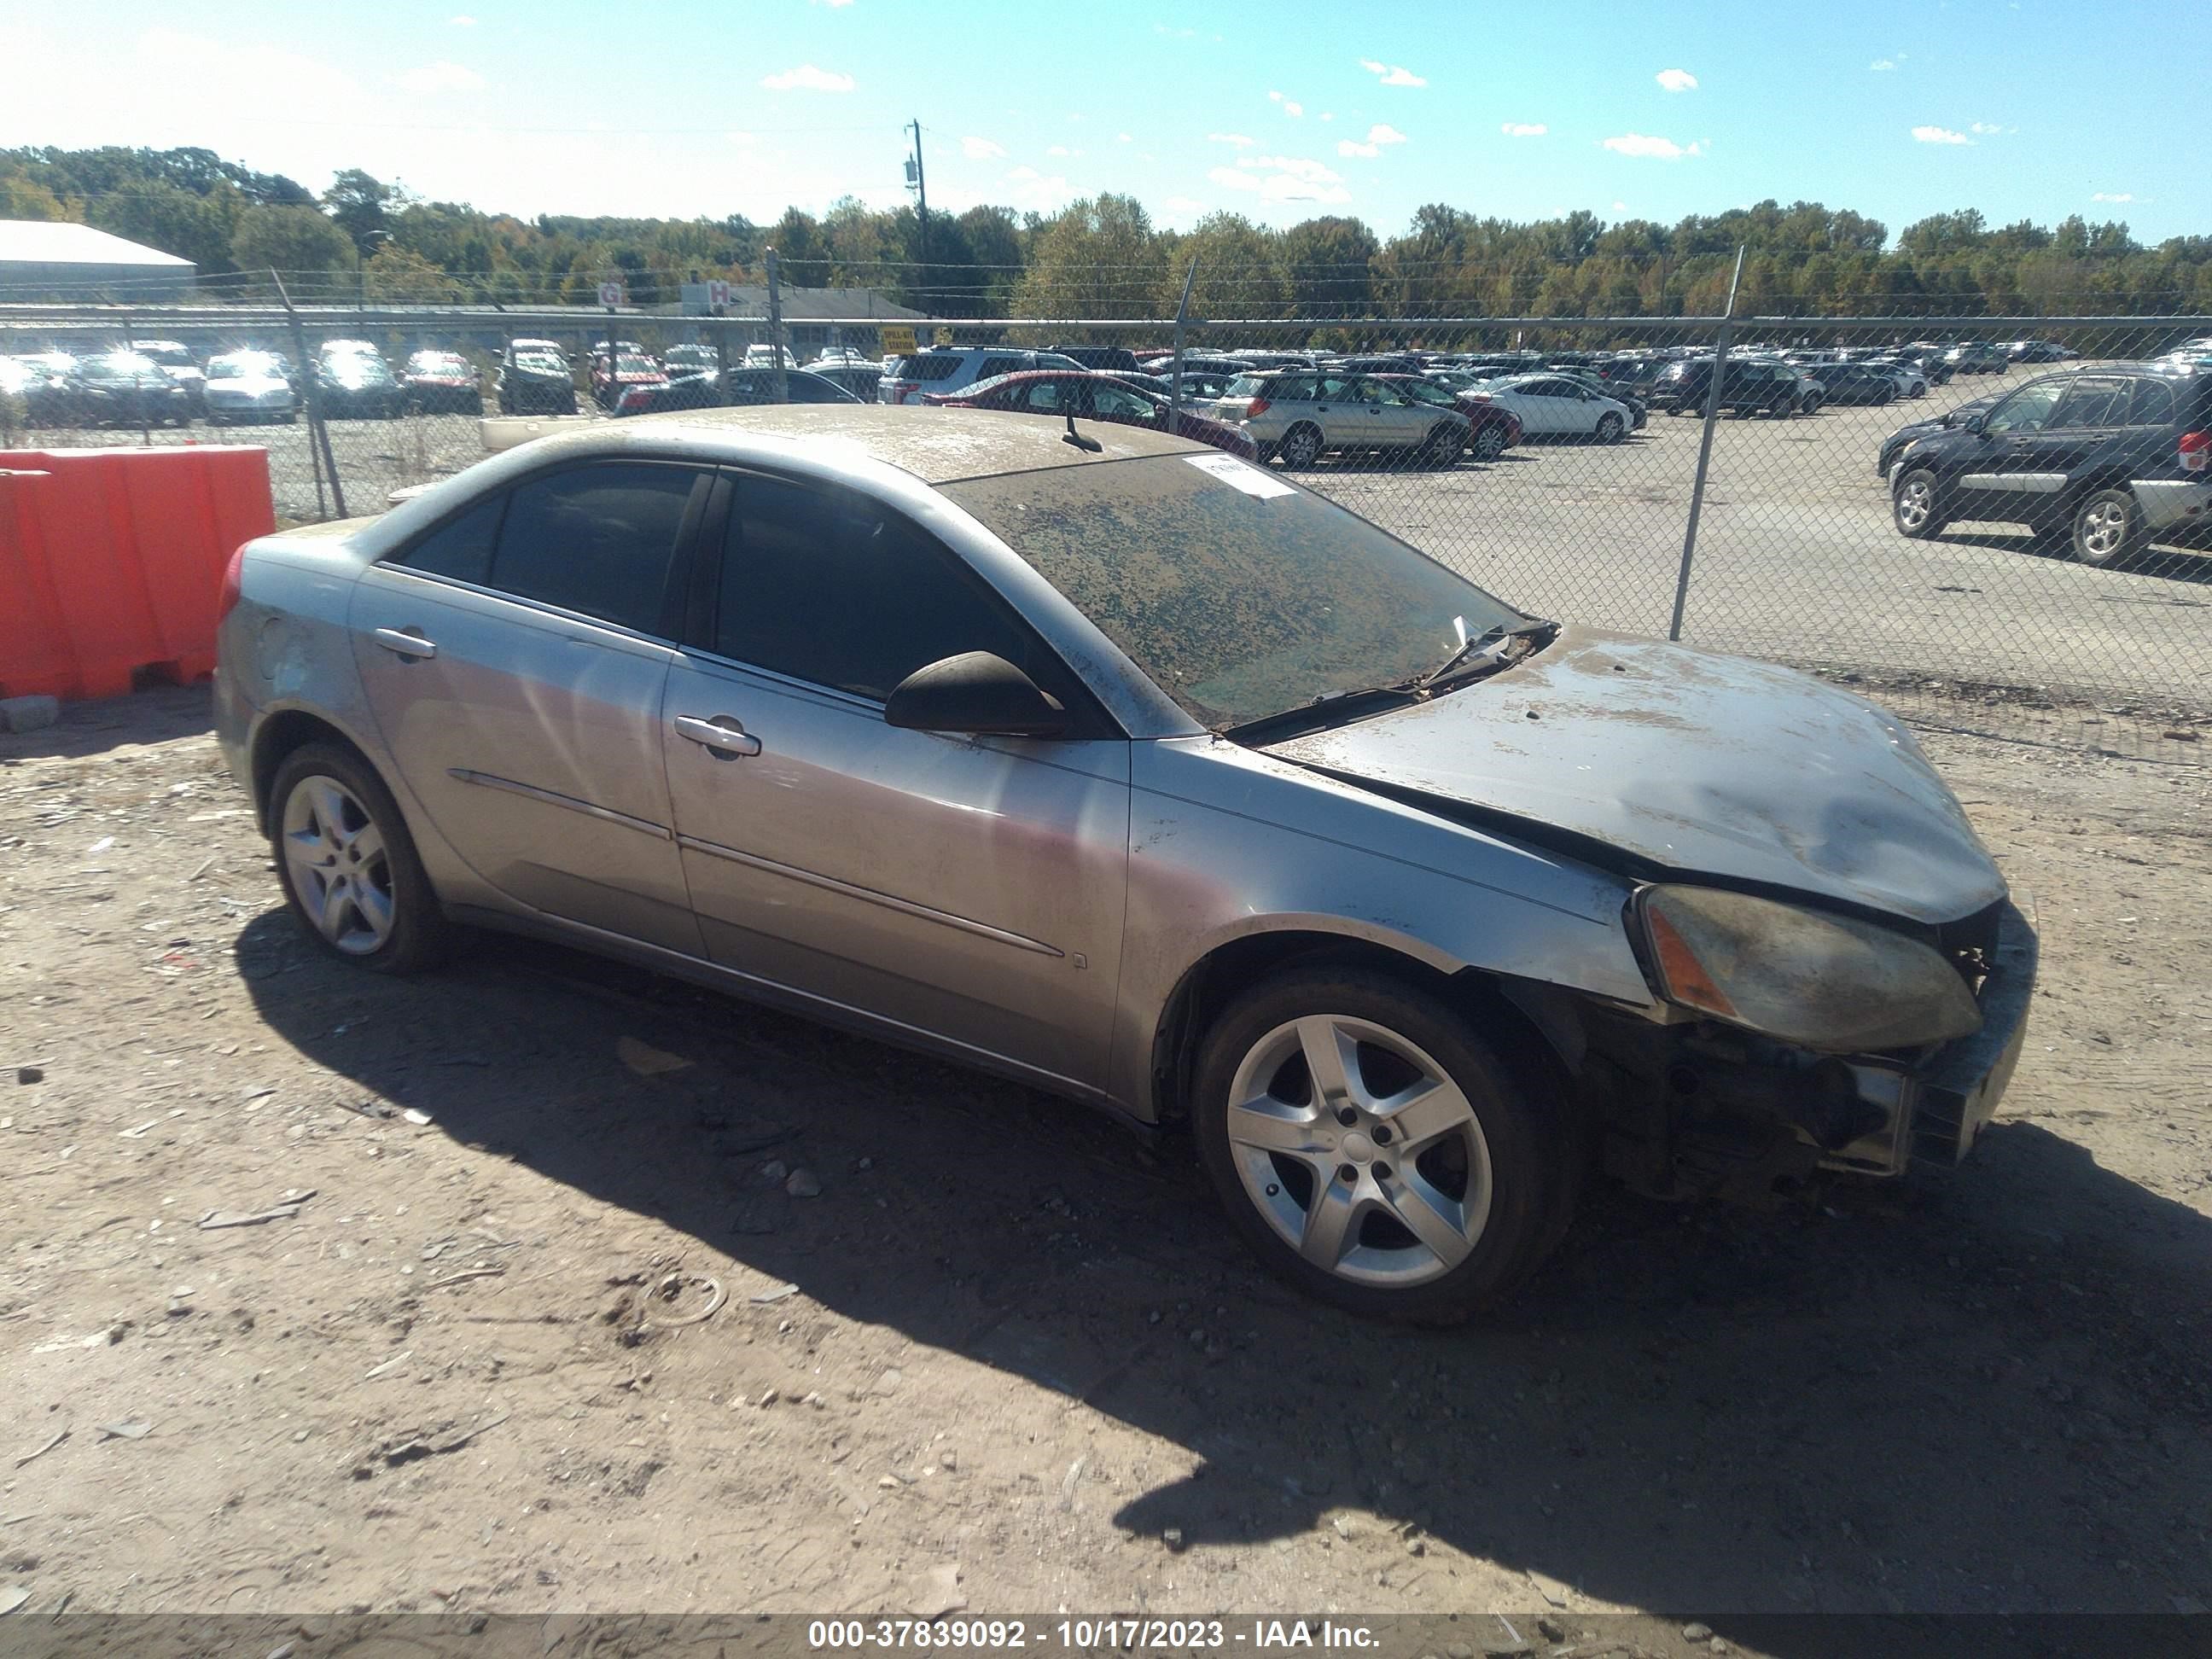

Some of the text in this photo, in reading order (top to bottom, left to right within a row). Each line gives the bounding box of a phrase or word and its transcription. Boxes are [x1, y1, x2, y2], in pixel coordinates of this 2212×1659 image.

[601, 286, 619, 304] G
[710, 283, 728, 303] H
[888, 341, 915, 350] STATION
